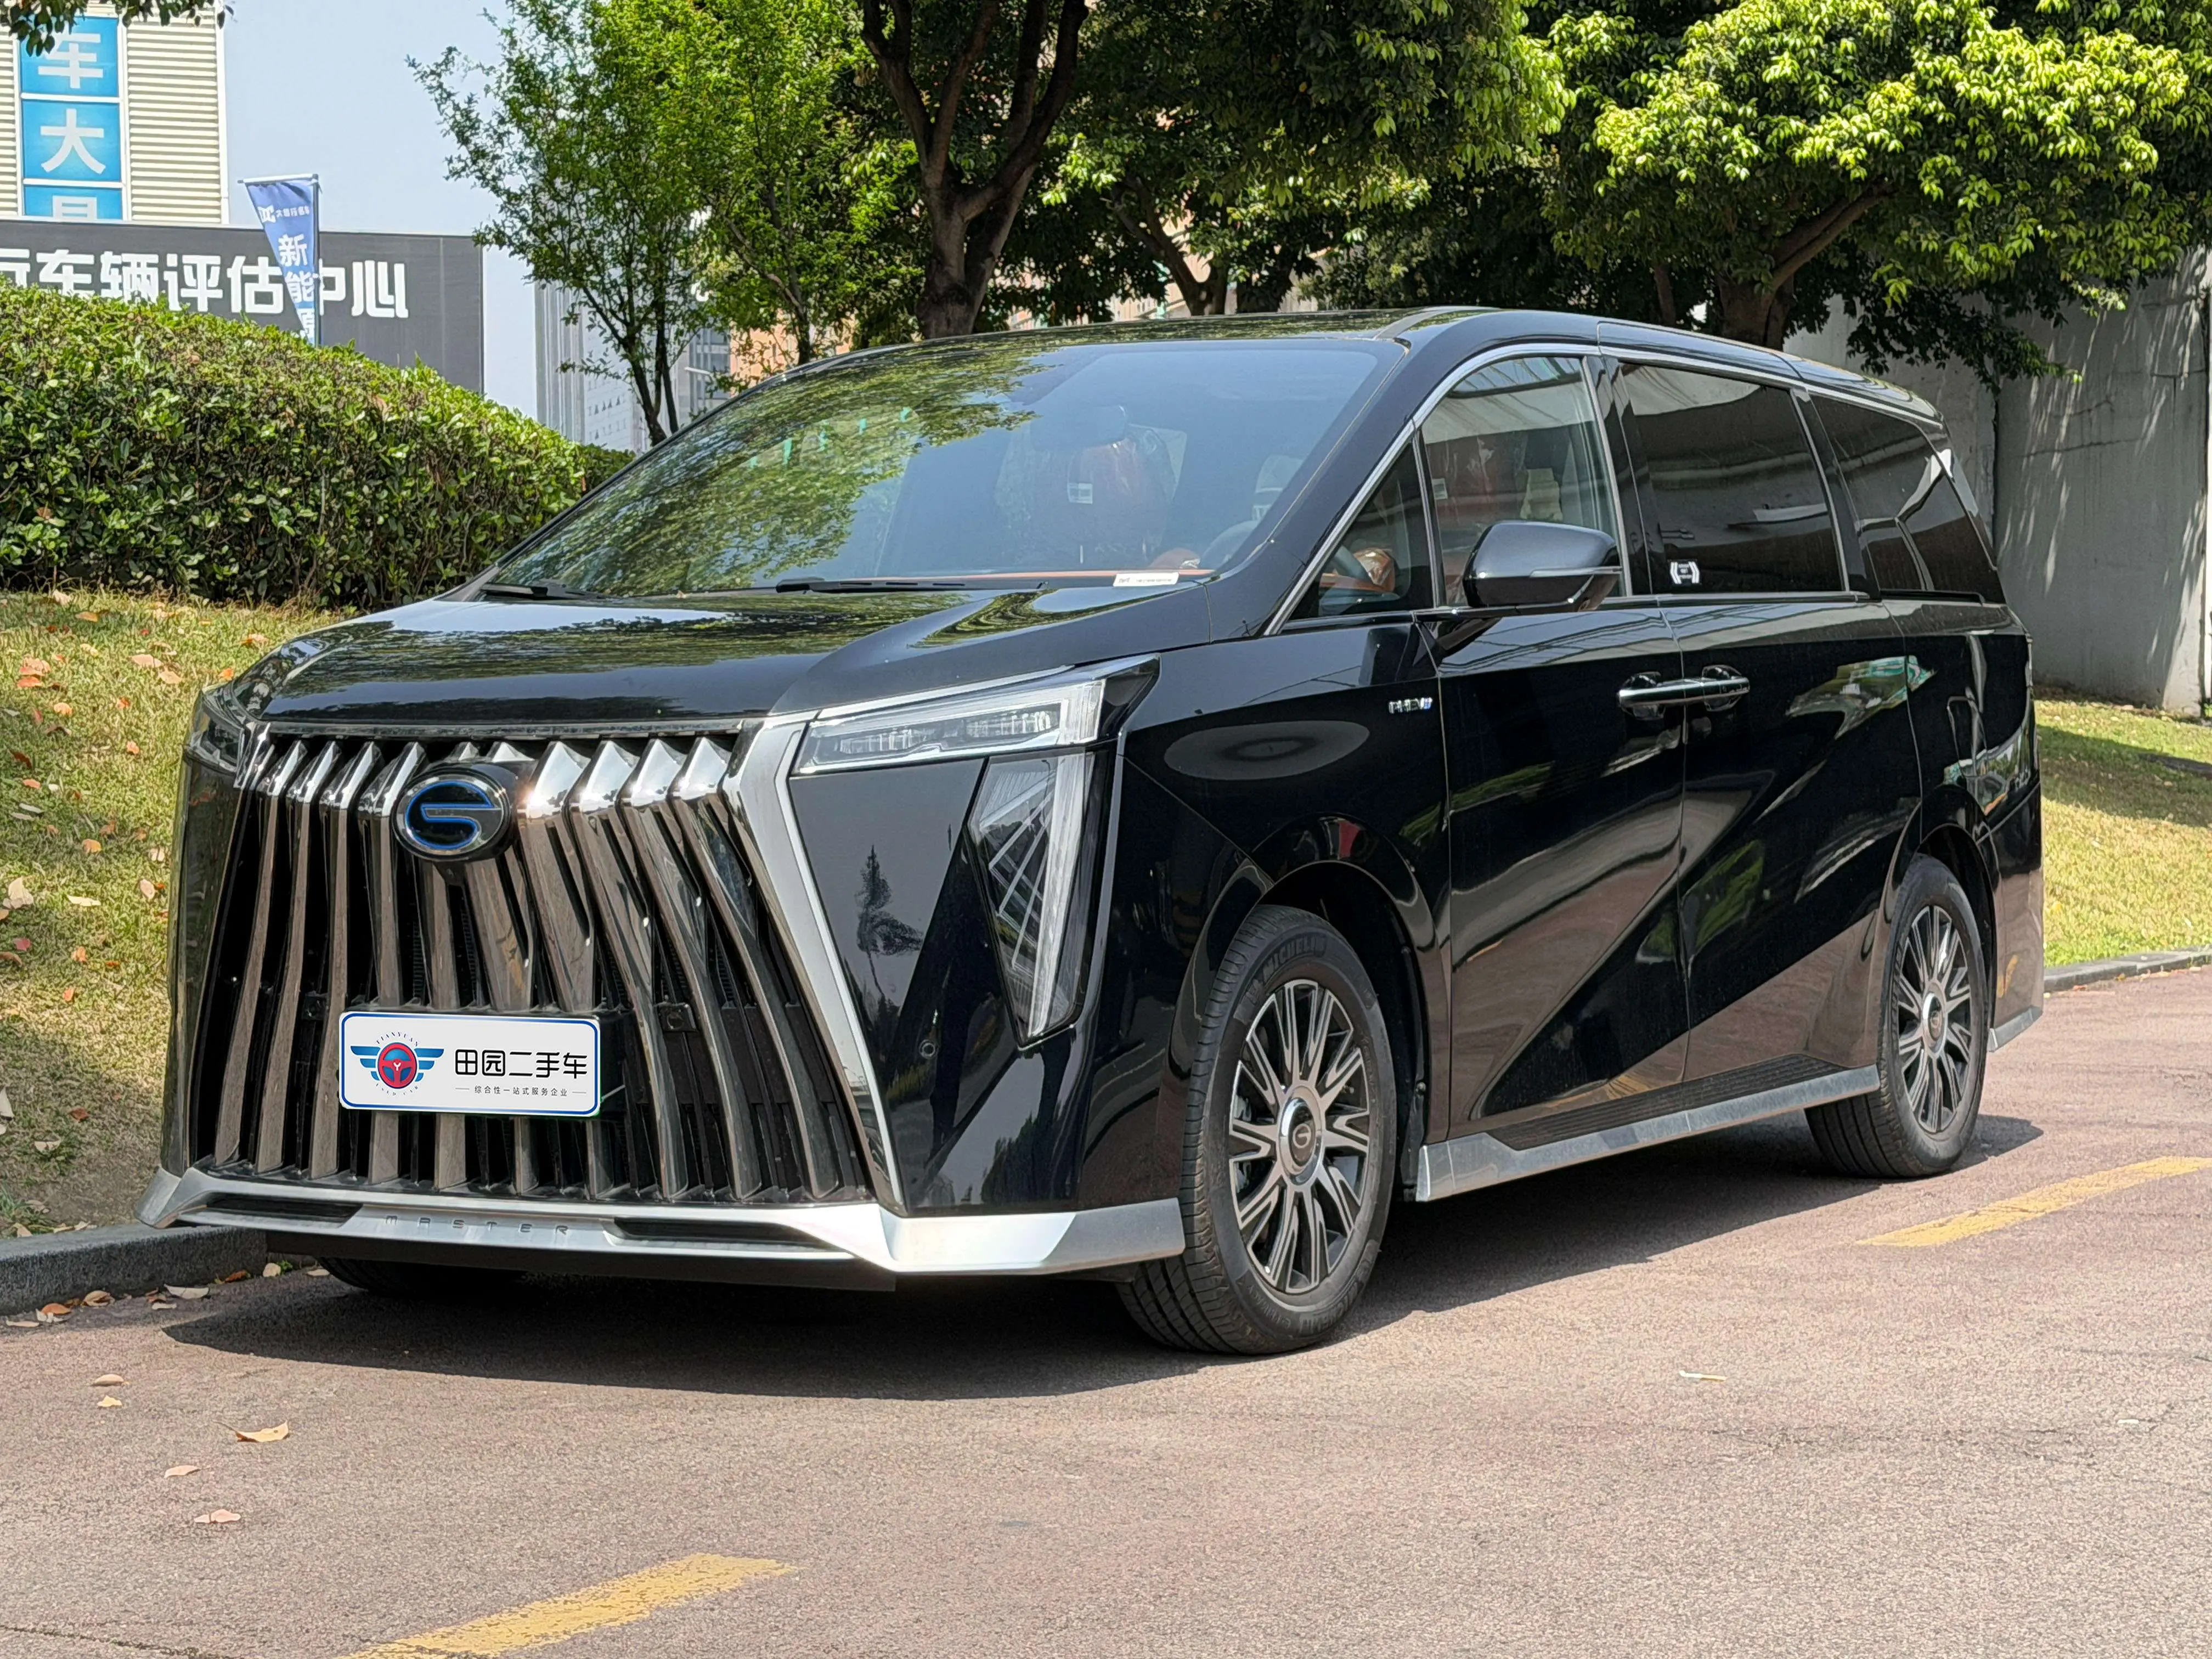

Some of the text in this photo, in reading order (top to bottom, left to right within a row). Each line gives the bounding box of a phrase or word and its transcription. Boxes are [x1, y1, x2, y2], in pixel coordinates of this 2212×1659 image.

[455, 1049, 588, 1079] 田园二手车
[474, 1085, 568, 1097] 综合性一站式服务企业
[386, 1214, 569, 1236] MASTER
